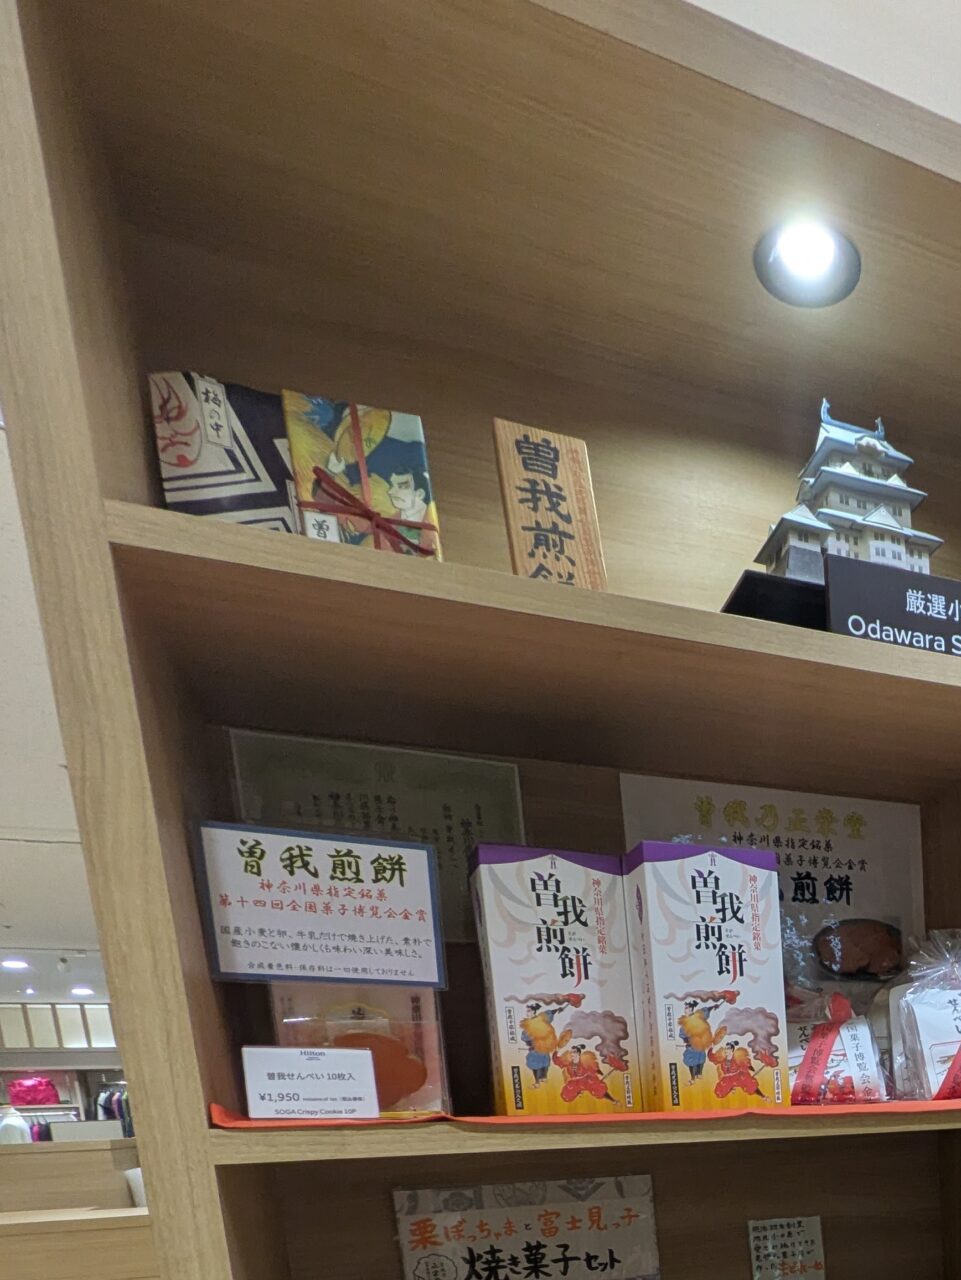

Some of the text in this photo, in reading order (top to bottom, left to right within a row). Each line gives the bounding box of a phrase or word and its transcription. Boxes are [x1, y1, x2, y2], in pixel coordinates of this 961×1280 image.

[848, 614, 945, 651] Odawara
[237, 838, 408, 888] 曽我煎餅
[258, 878, 388, 902] 神奈川県指定銘菓
[778, 870, 853, 906] 煎餅
[530, 871, 592, 988] 曽我煎餅
[691, 869, 748, 985] 曽我煎餅
[259, 1092, 300, 1103] ¥1,950
